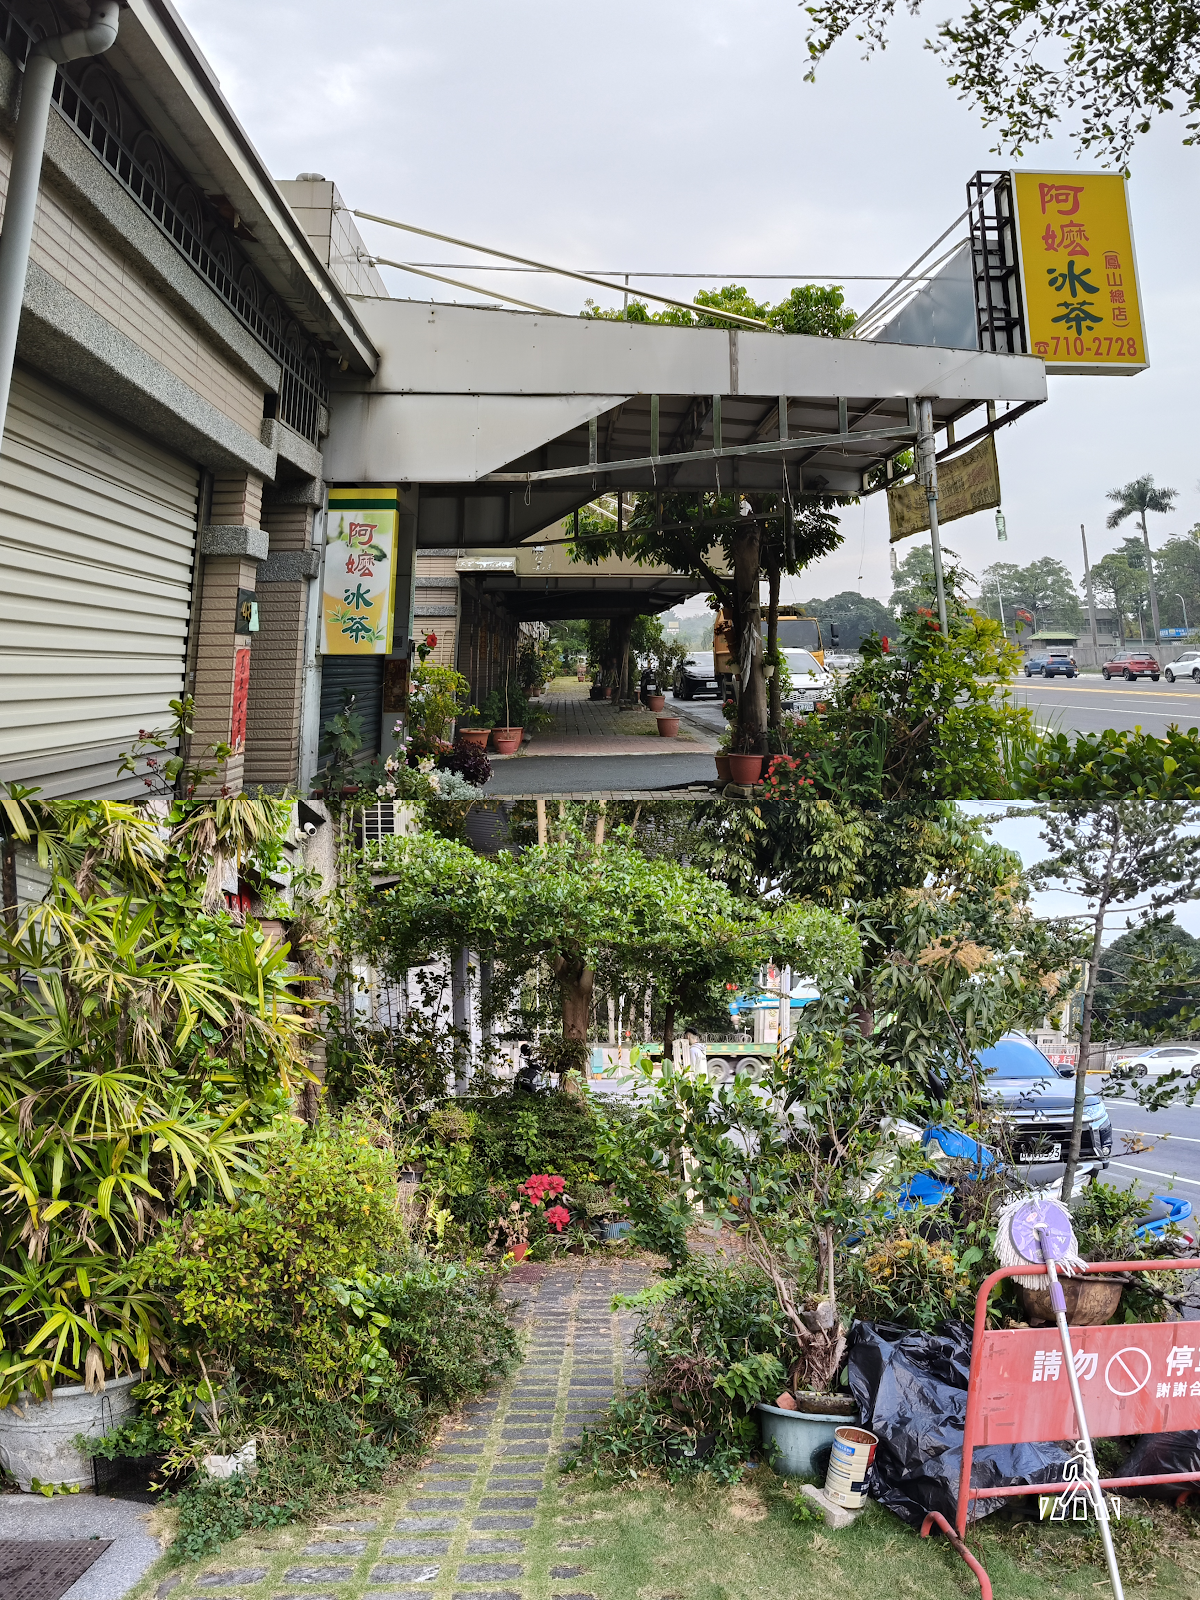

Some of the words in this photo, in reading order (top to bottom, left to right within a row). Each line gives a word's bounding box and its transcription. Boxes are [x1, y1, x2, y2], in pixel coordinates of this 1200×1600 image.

[1038, 183, 1103, 336] 阿嬤冰茶
[1050, 336, 1138, 357] 710-2728
[341, 522, 378, 644] 阿嬤冰茶
[1032, 1348, 1099, 1382] 請勿
